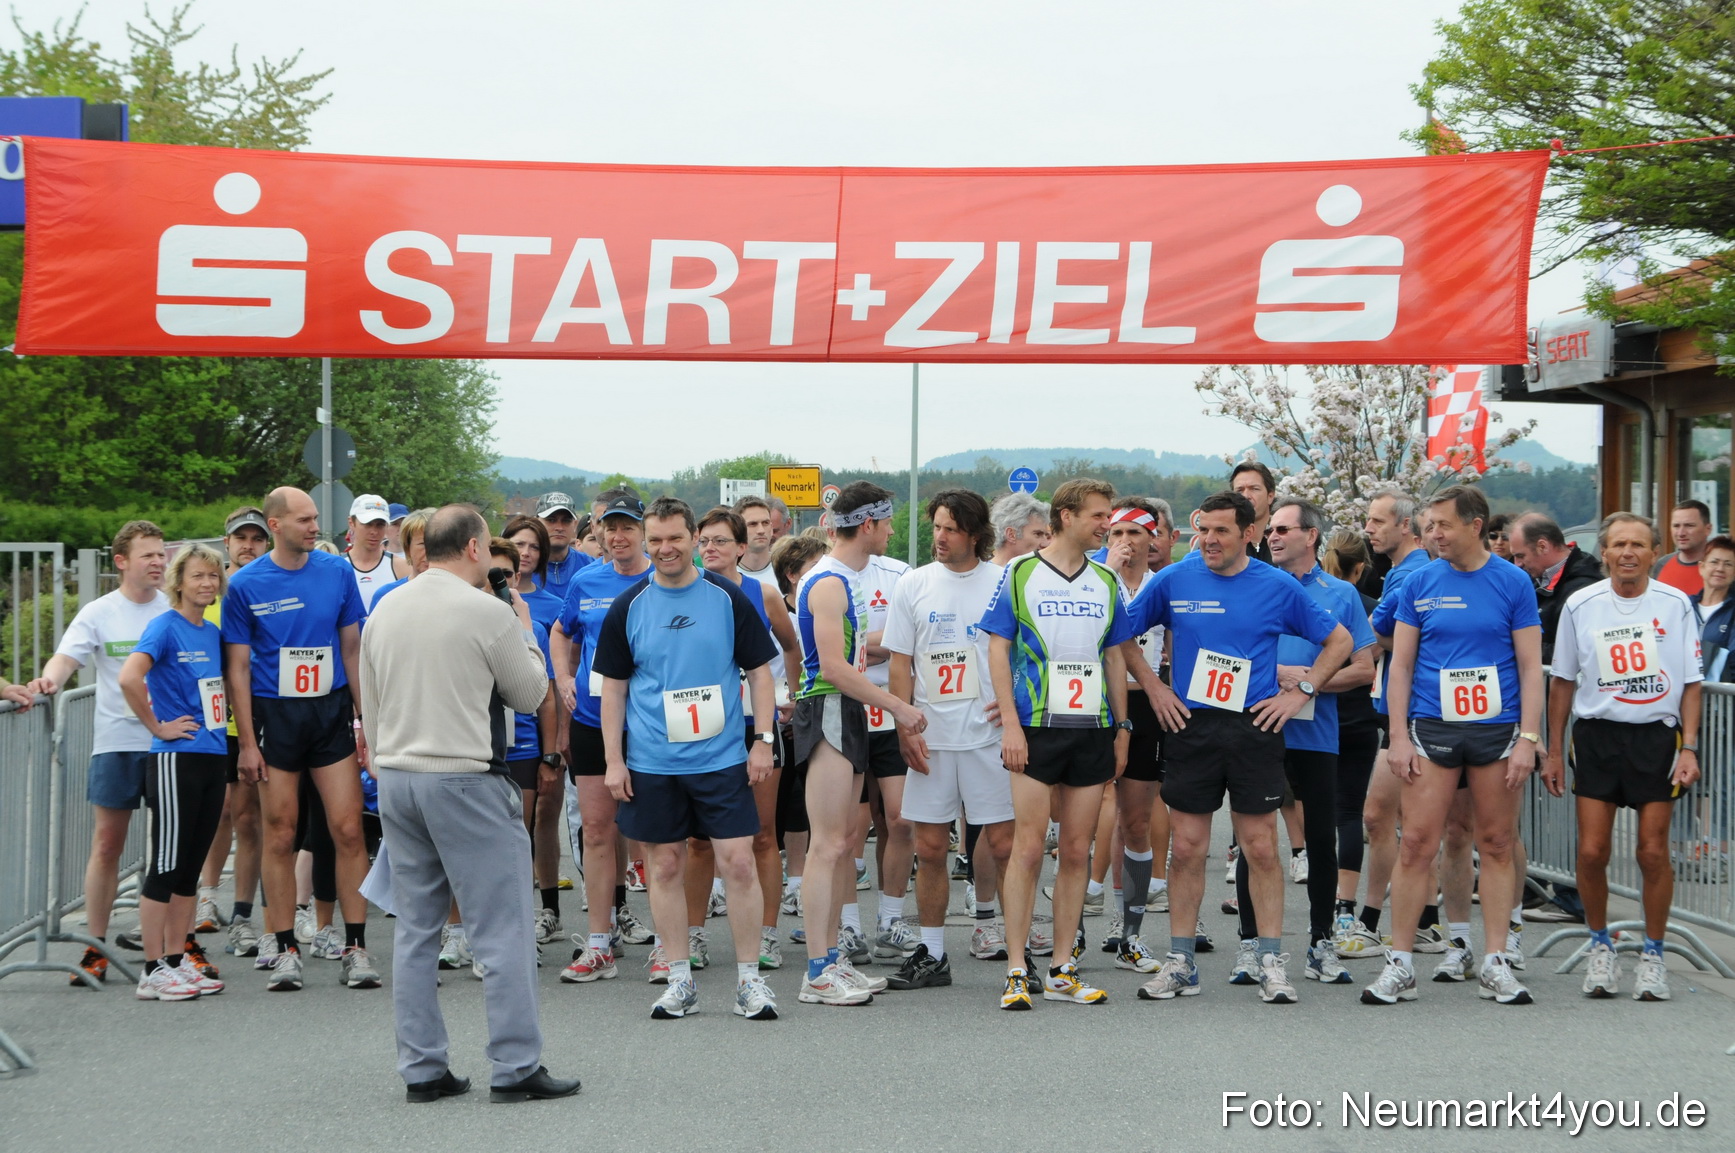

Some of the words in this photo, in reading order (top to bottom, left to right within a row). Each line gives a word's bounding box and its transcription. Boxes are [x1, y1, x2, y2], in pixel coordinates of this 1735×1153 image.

[1546, 330, 1590, 364] SEAT
[774, 481, 816, 492] Neumarkt
[1038, 589, 1070, 597] TEAM
[1038, 601, 1104, 618] BOCK
[1603, 628, 1630, 638] MEYER
[930, 652, 955, 661] MEYER
[1206, 654, 1231, 666] MEYER
[1610, 641, 1647, 674] 86
[1205, 661, 1231, 671] WERBUNG
[1449, 670, 1476, 678] MEYER
[295, 664, 320, 693] 61
[938, 663, 966, 695] 27
[1206, 669, 1234, 702] 16
[672, 690, 699, 700] MEYER
[1068, 678, 1083, 709] 2
[1454, 684, 1488, 716] 66
[687, 703, 700, 734] 1
